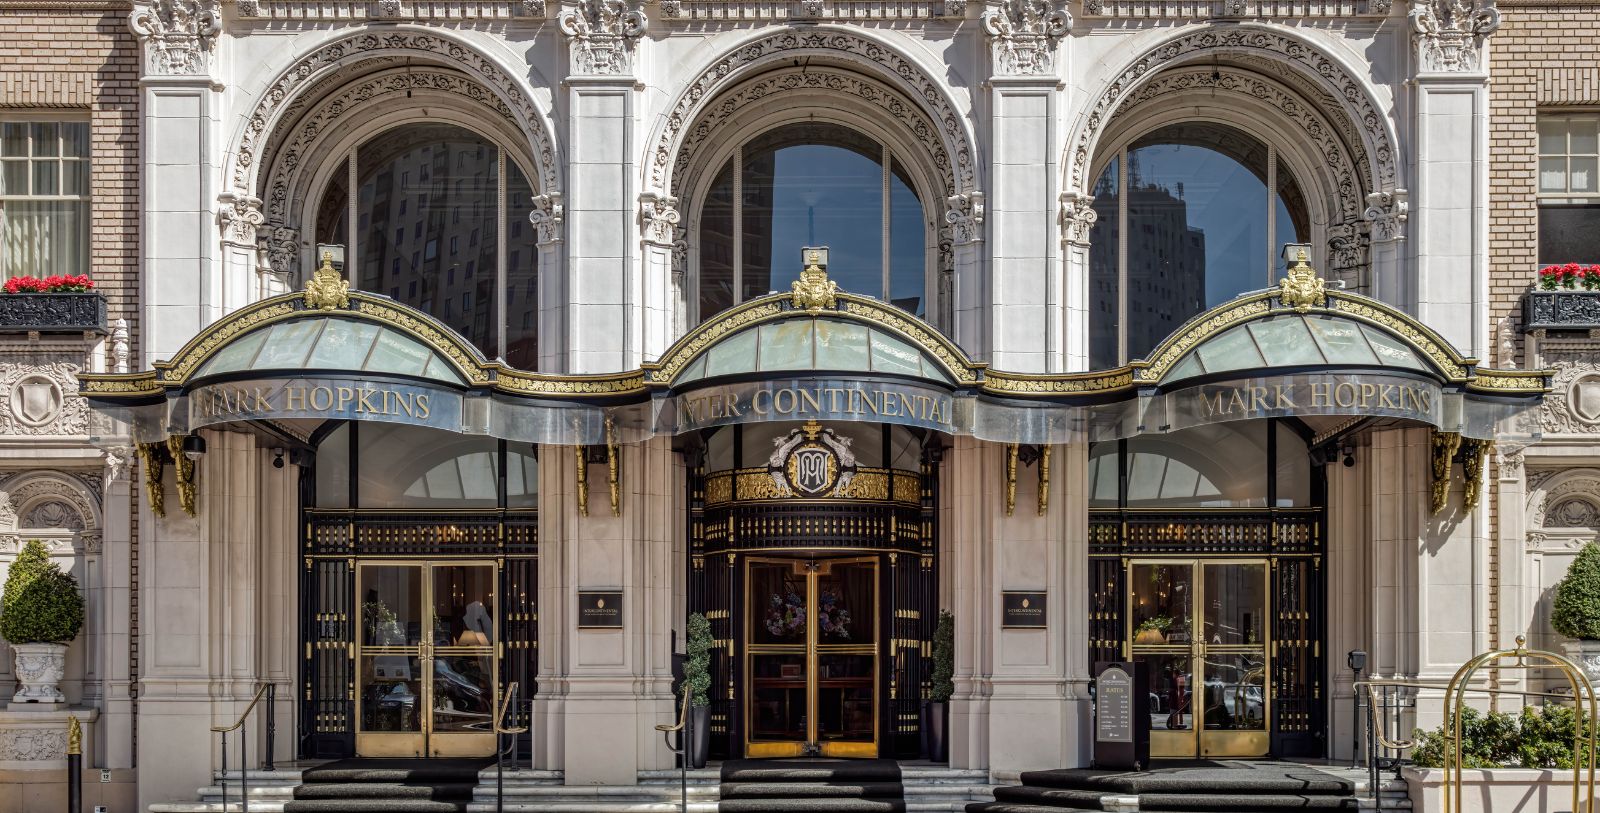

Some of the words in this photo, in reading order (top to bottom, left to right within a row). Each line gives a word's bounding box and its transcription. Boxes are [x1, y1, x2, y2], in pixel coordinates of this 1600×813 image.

[197, 386, 274, 417] MARK
[285, 386, 430, 419] HOPKINS
[752, 387, 951, 425] CONTINENTAL
[1200, 382, 1297, 417] MARK
[1310, 381, 1430, 415] HOPKINS
